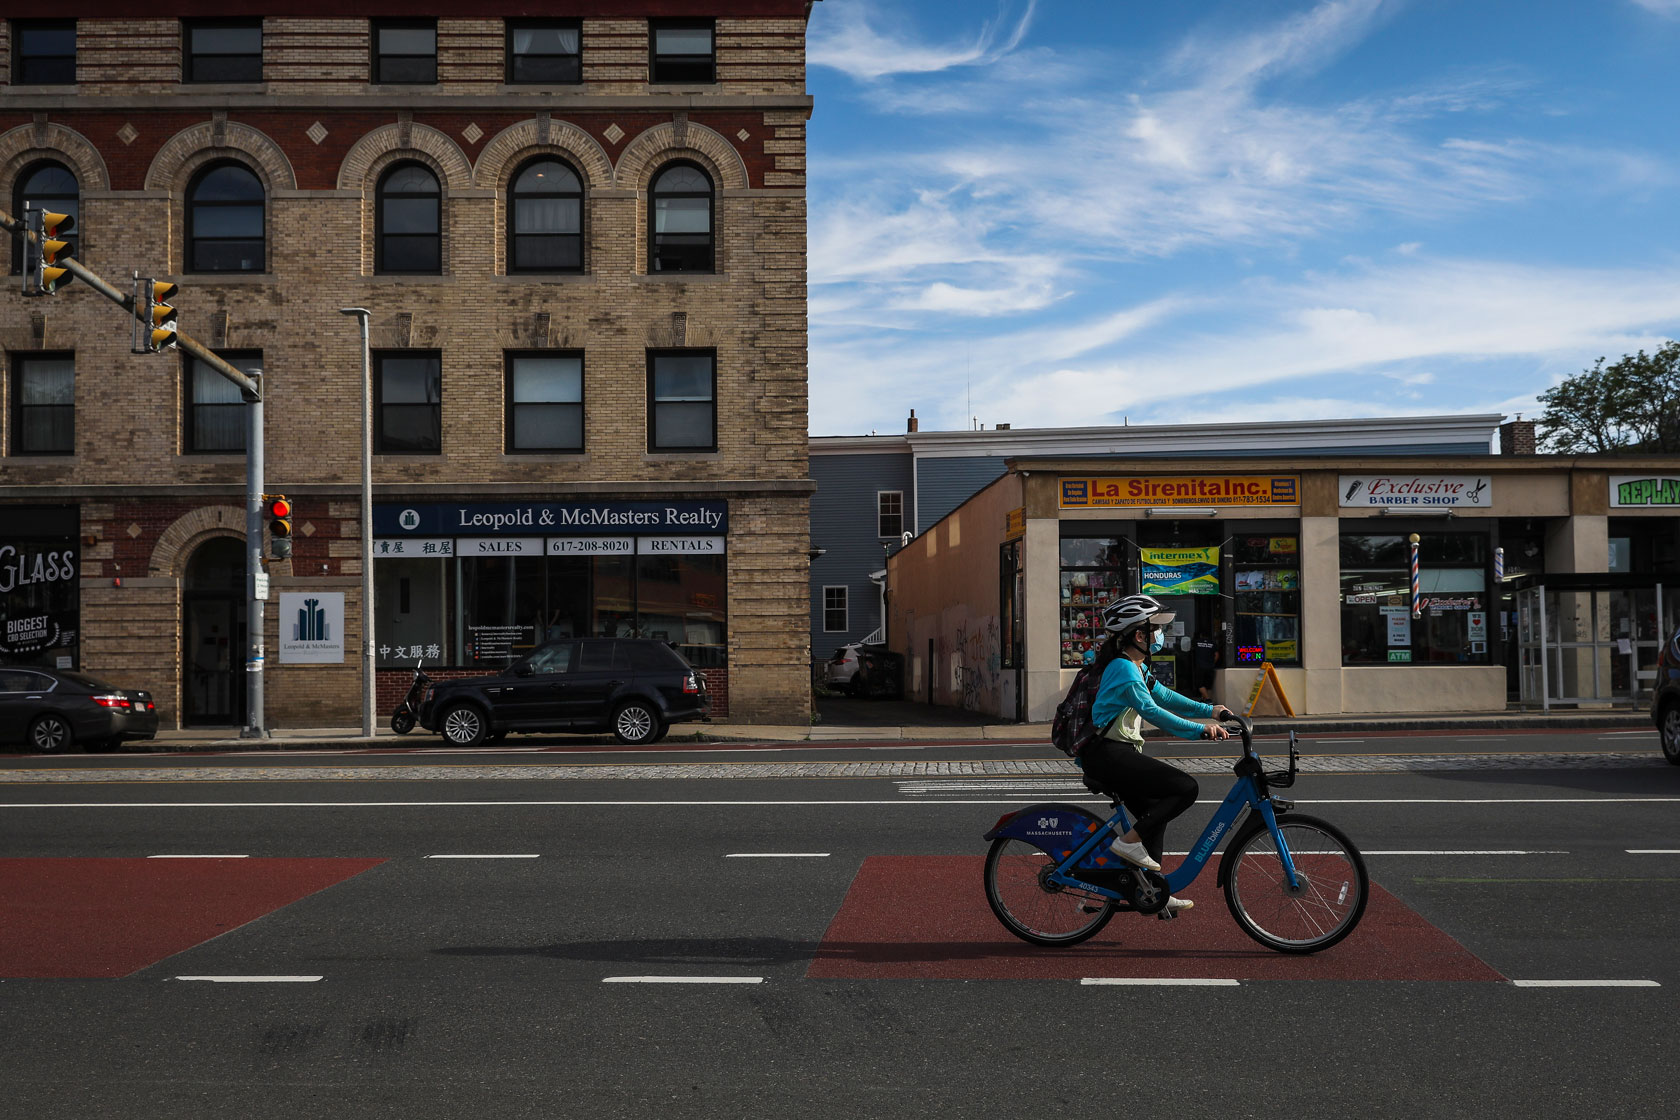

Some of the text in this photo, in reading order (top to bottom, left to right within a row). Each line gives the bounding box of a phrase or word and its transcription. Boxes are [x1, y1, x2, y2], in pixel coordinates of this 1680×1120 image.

[1091, 479, 1119, 498] La
[1367, 478, 1465, 495] Exclusive
[1369, 496, 1459, 504] BARBER SHOP
[459, 507, 723, 532] Leopold & McMasters Realty
[422, 541, 452, 555] 租屋
[478, 541, 522, 552] SALES
[553, 541, 629, 552] 617-208-8020
[651, 540, 713, 551] RENTALS
[1149, 551, 1203, 560] intermex
[0, 545, 75, 593] GLASS
[1143, 571, 1182, 579] HONDURAS
[7, 615, 49, 634] BIGGEST
[19, 629, 48, 641] SELECTION
[379, 643, 441, 660] 中文服務
[1390, 652, 1410, 661] ATM
[1194, 822, 1225, 864] BLUEbikes
[1078, 882, 1099, 893] 40343
